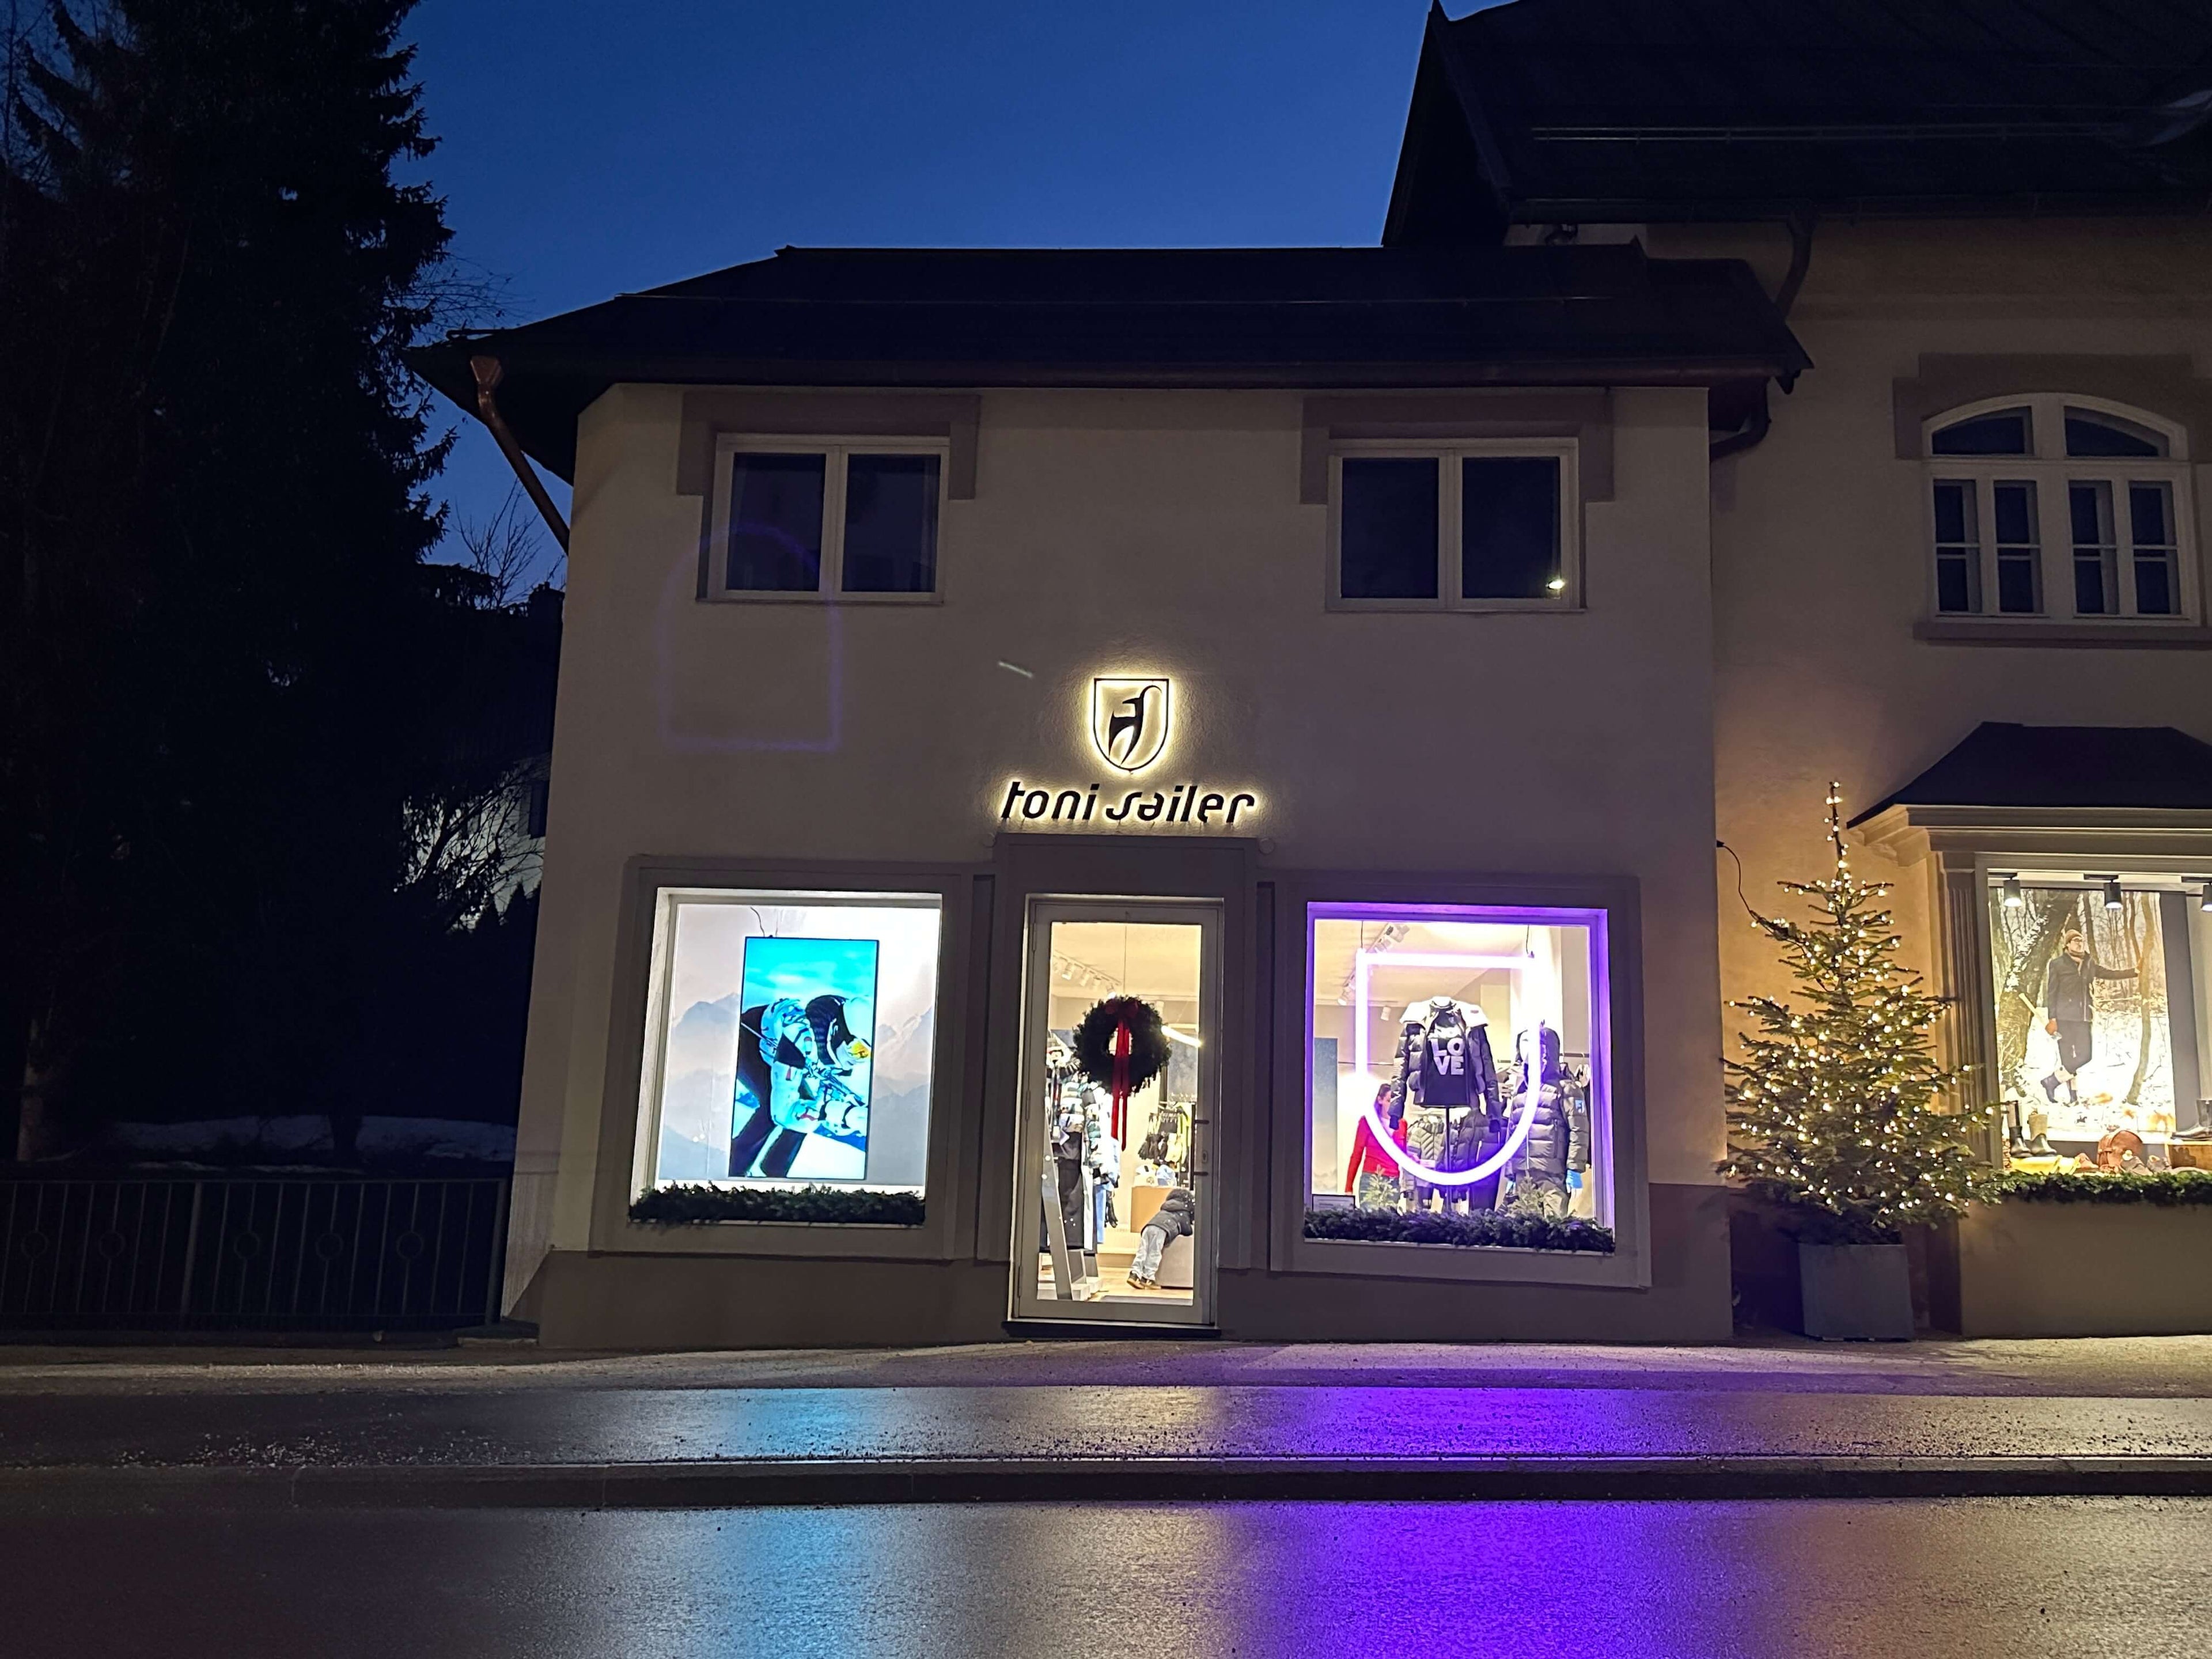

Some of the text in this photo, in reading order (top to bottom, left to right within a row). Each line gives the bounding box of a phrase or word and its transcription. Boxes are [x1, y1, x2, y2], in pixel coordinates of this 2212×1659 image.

[1001, 781, 1255, 823] toni sailer
[1430, 1037, 1465, 1056] LO
[1433, 1055, 1464, 1075] VE
